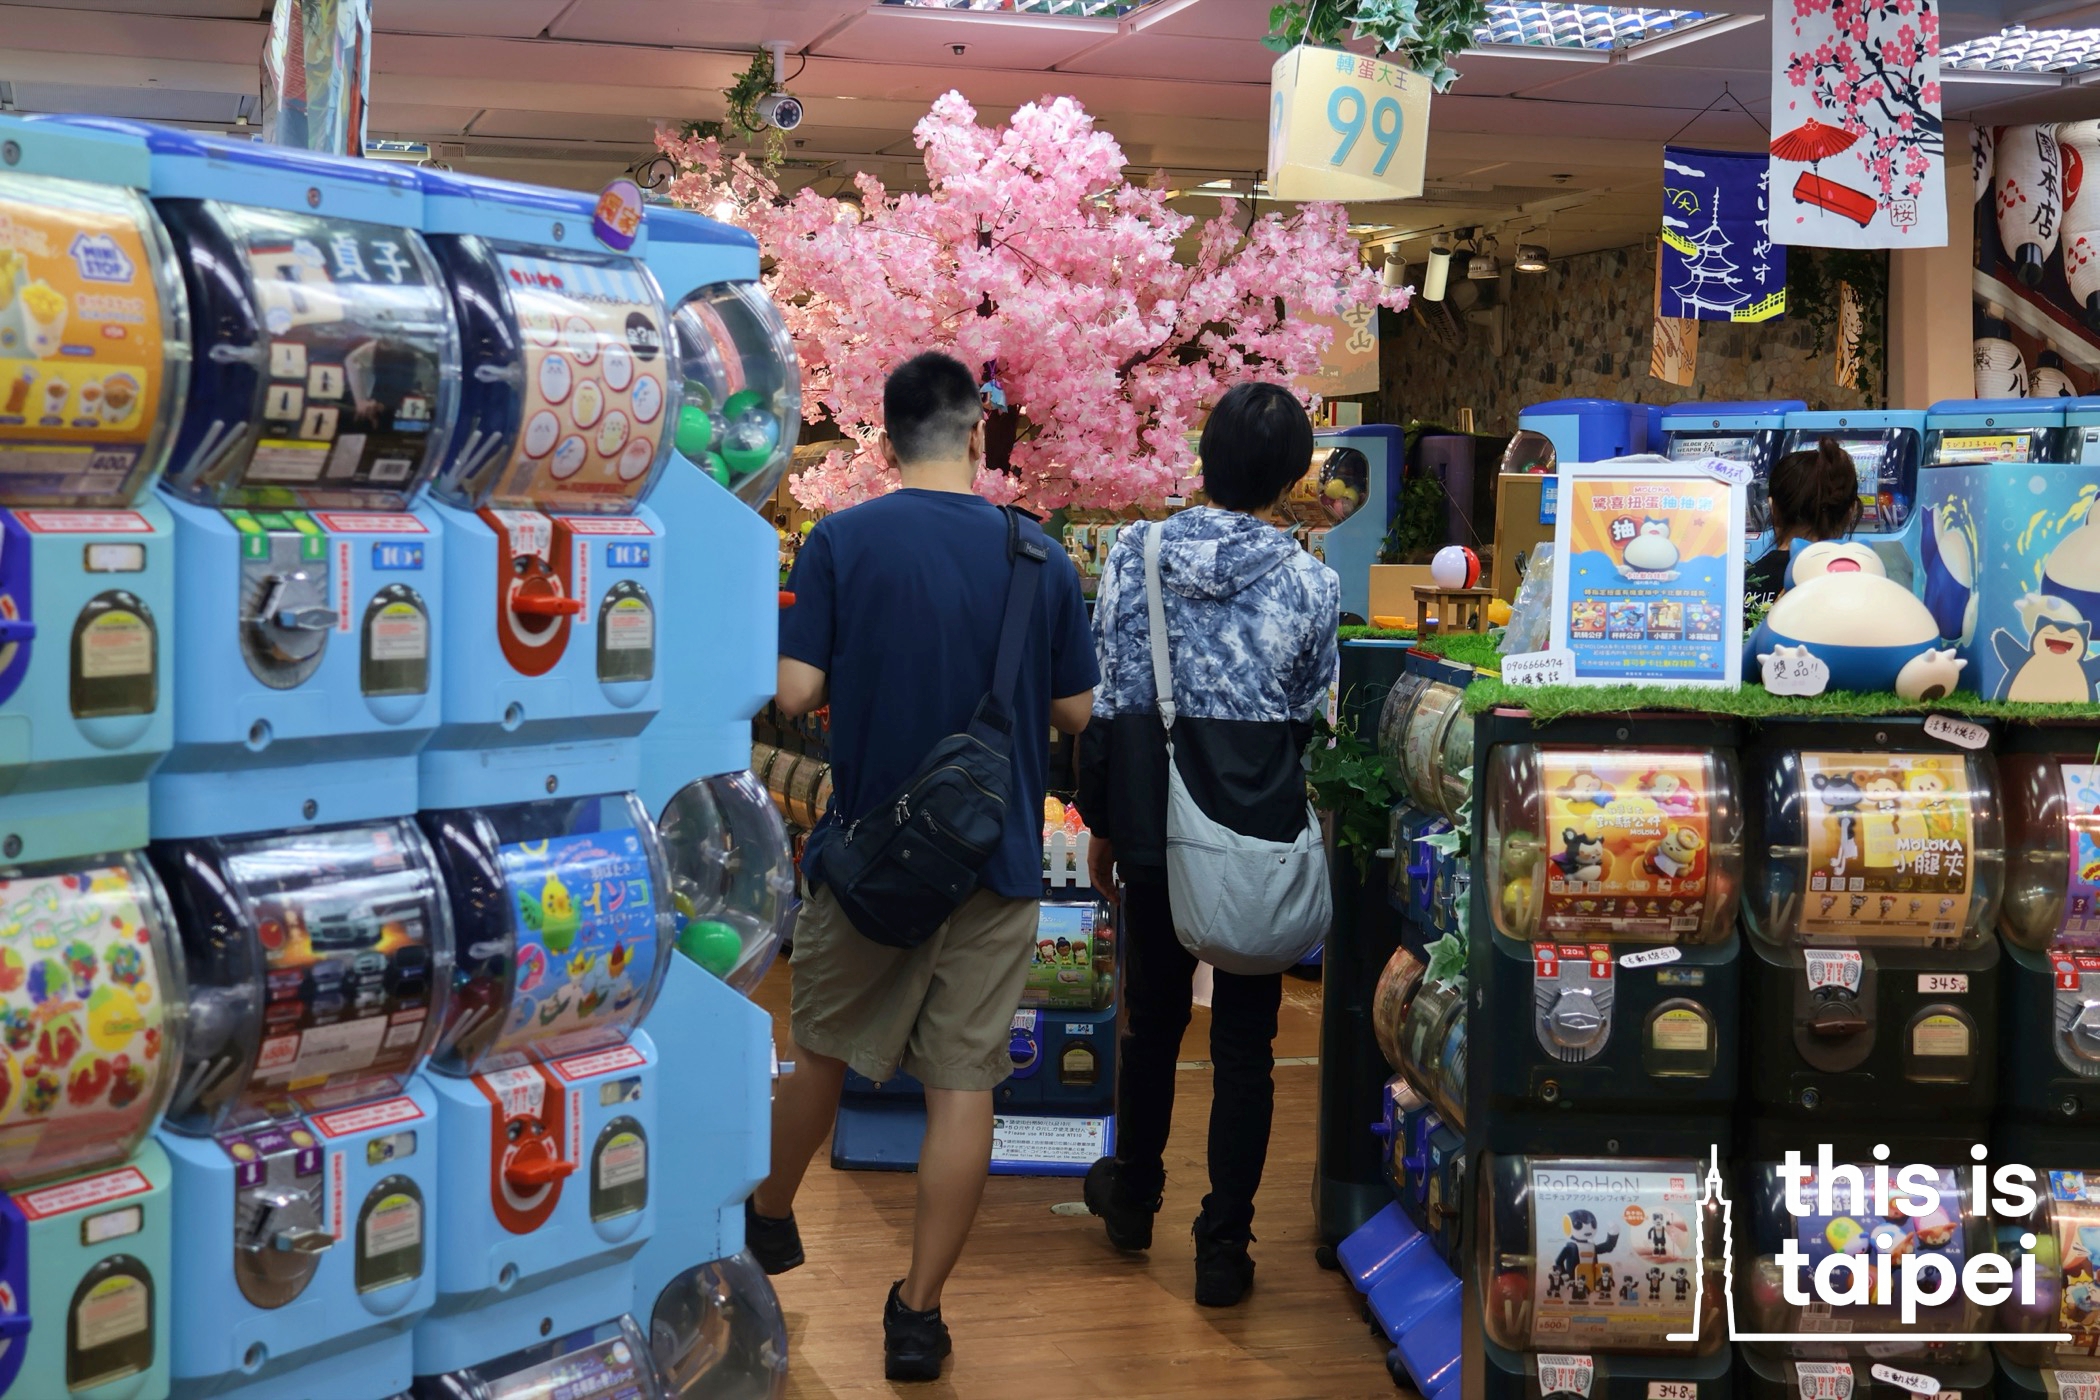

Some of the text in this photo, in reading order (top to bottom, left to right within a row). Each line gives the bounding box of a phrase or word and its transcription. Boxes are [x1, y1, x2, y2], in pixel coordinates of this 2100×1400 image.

[1335, 54, 1408, 91] 轉蛋大王
[1327, 85, 1404, 176] 99
[1893, 203, 1914, 223] 桜
[82, 246, 118, 259] MINI
[330, 232, 411, 284] 貞子
[85, 260, 122, 275] STOP
[1634, 486, 1671, 494] MOLOKA
[1591, 496, 1714, 511] 驚喜扭蛋抽抽樂
[1612, 519, 1636, 541] 抽
[1897, 839, 1963, 851] MOLOKA
[1893, 852, 1964, 876] 小腿夾
[583, 878, 650, 916] インコ
[1929, 977, 1958, 990] 345
[1537, 1174, 1639, 1193] RoBoHoN
[1659, 1384, 1690, 1398] 348
